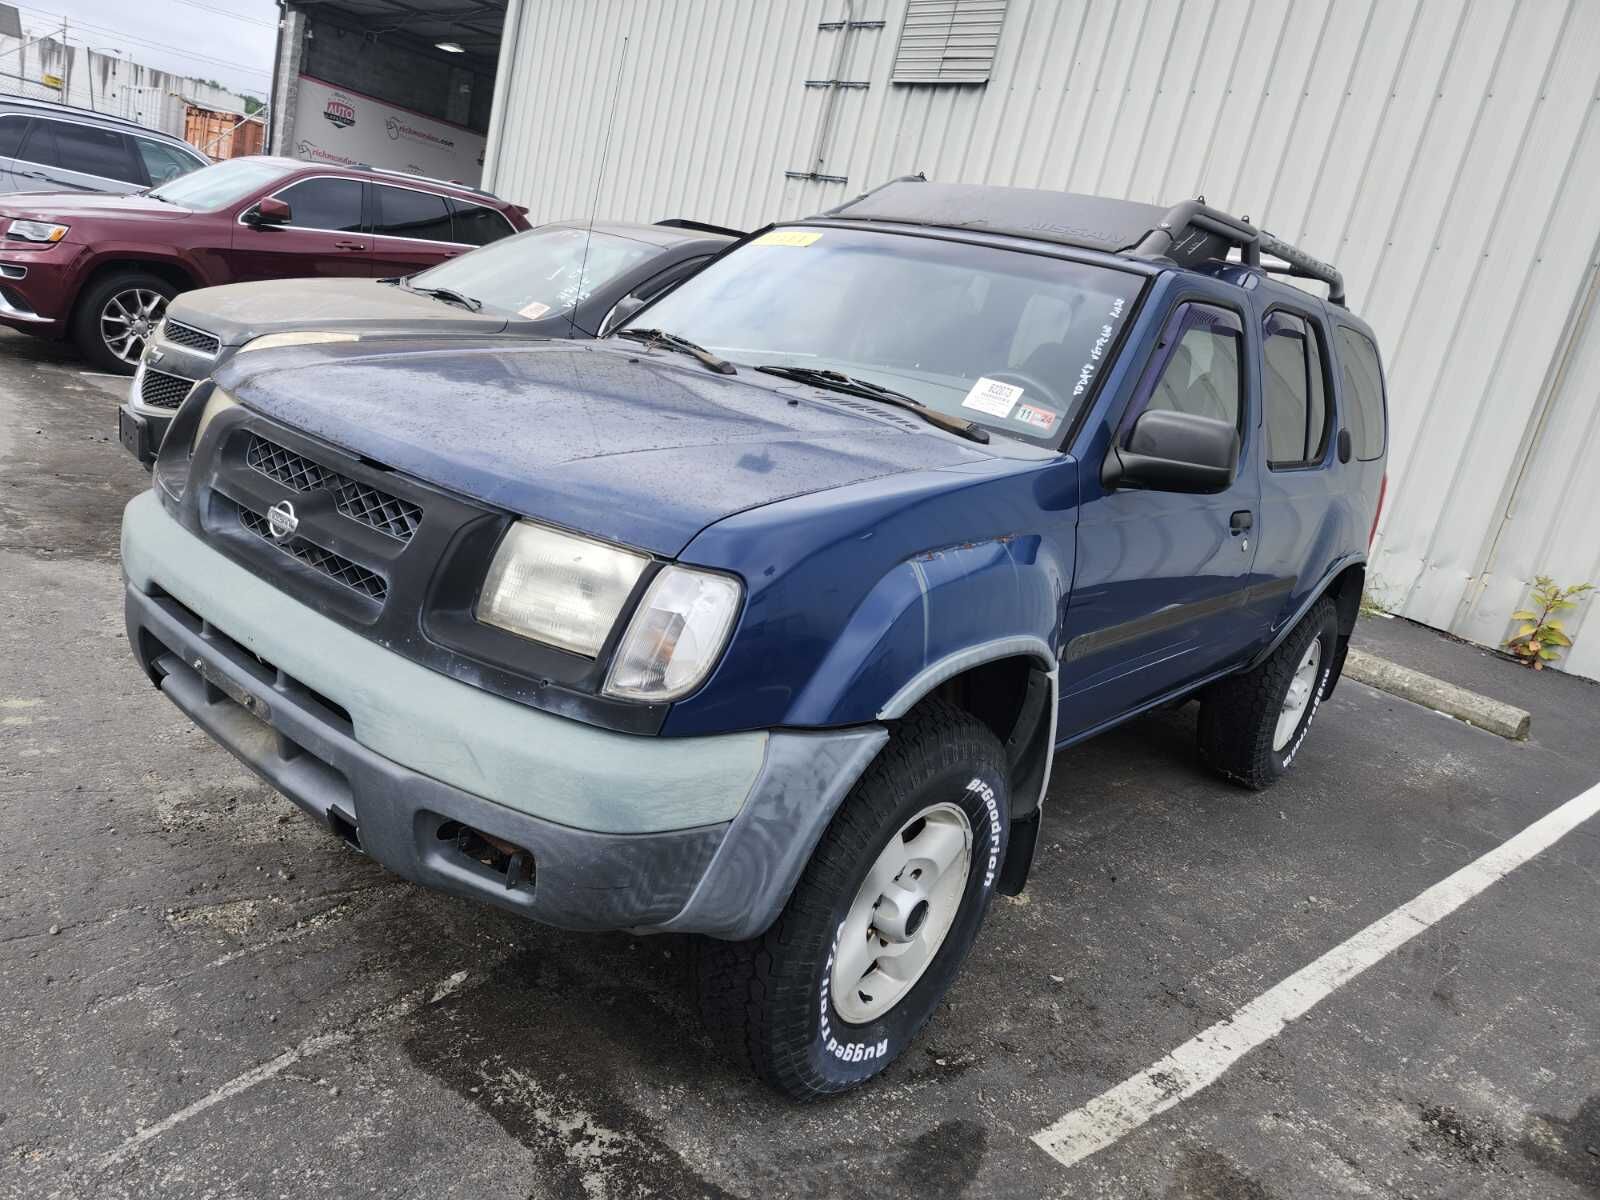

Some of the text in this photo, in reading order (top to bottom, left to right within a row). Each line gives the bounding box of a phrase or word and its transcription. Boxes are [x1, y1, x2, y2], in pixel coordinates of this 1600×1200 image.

[328, 103, 354, 119] AUTO
[1024, 223, 1127, 243] NISSAN
[1020, 408, 1032, 419] 11
[966, 778, 1002, 887] BFGoodrich
[820, 977, 831, 1041] Trail
[826, 1038, 888, 1062] Rugged
